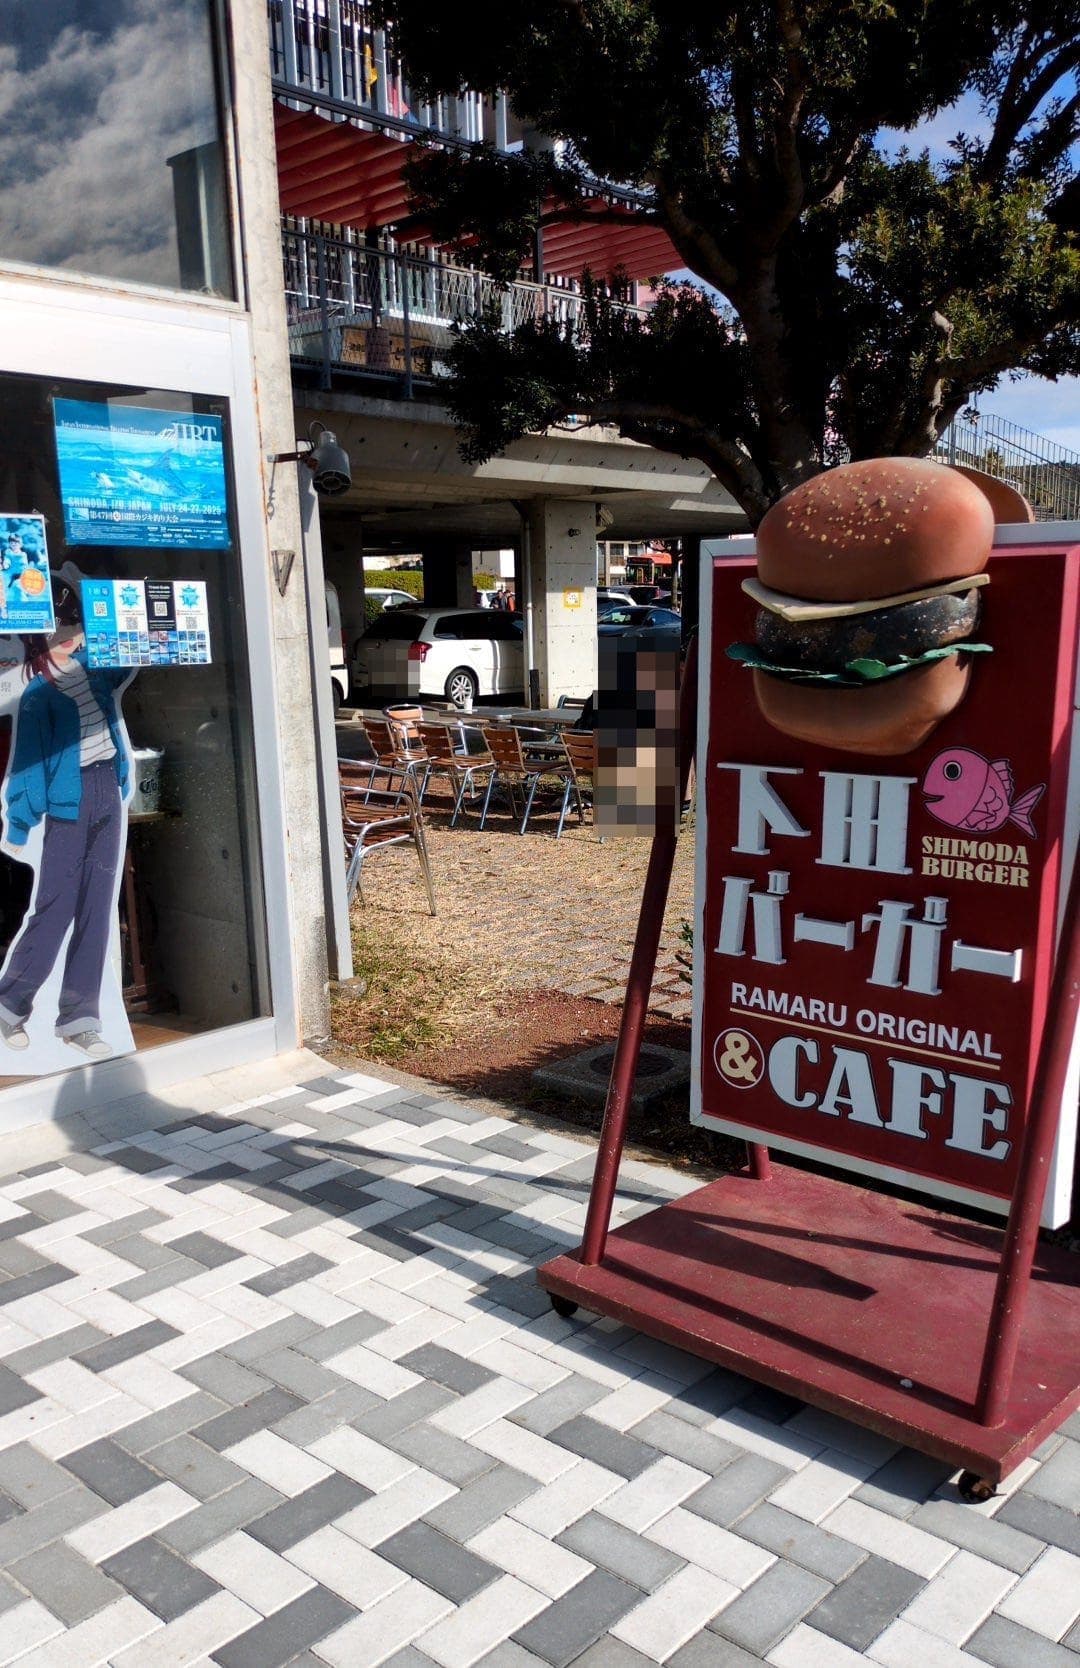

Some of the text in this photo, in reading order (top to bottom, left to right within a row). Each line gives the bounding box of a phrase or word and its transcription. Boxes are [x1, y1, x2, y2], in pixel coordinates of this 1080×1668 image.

[716, 762, 918, 875] 下田
[921, 836, 1029, 865] SHIMODA
[921, 857, 1029, 887] BURGER
[714, 870, 1023, 996] バーガー
[730, 982, 1002, 1060] RAMARU ORIGINAL
[719, 1032, 1013, 1161] & CAFE
